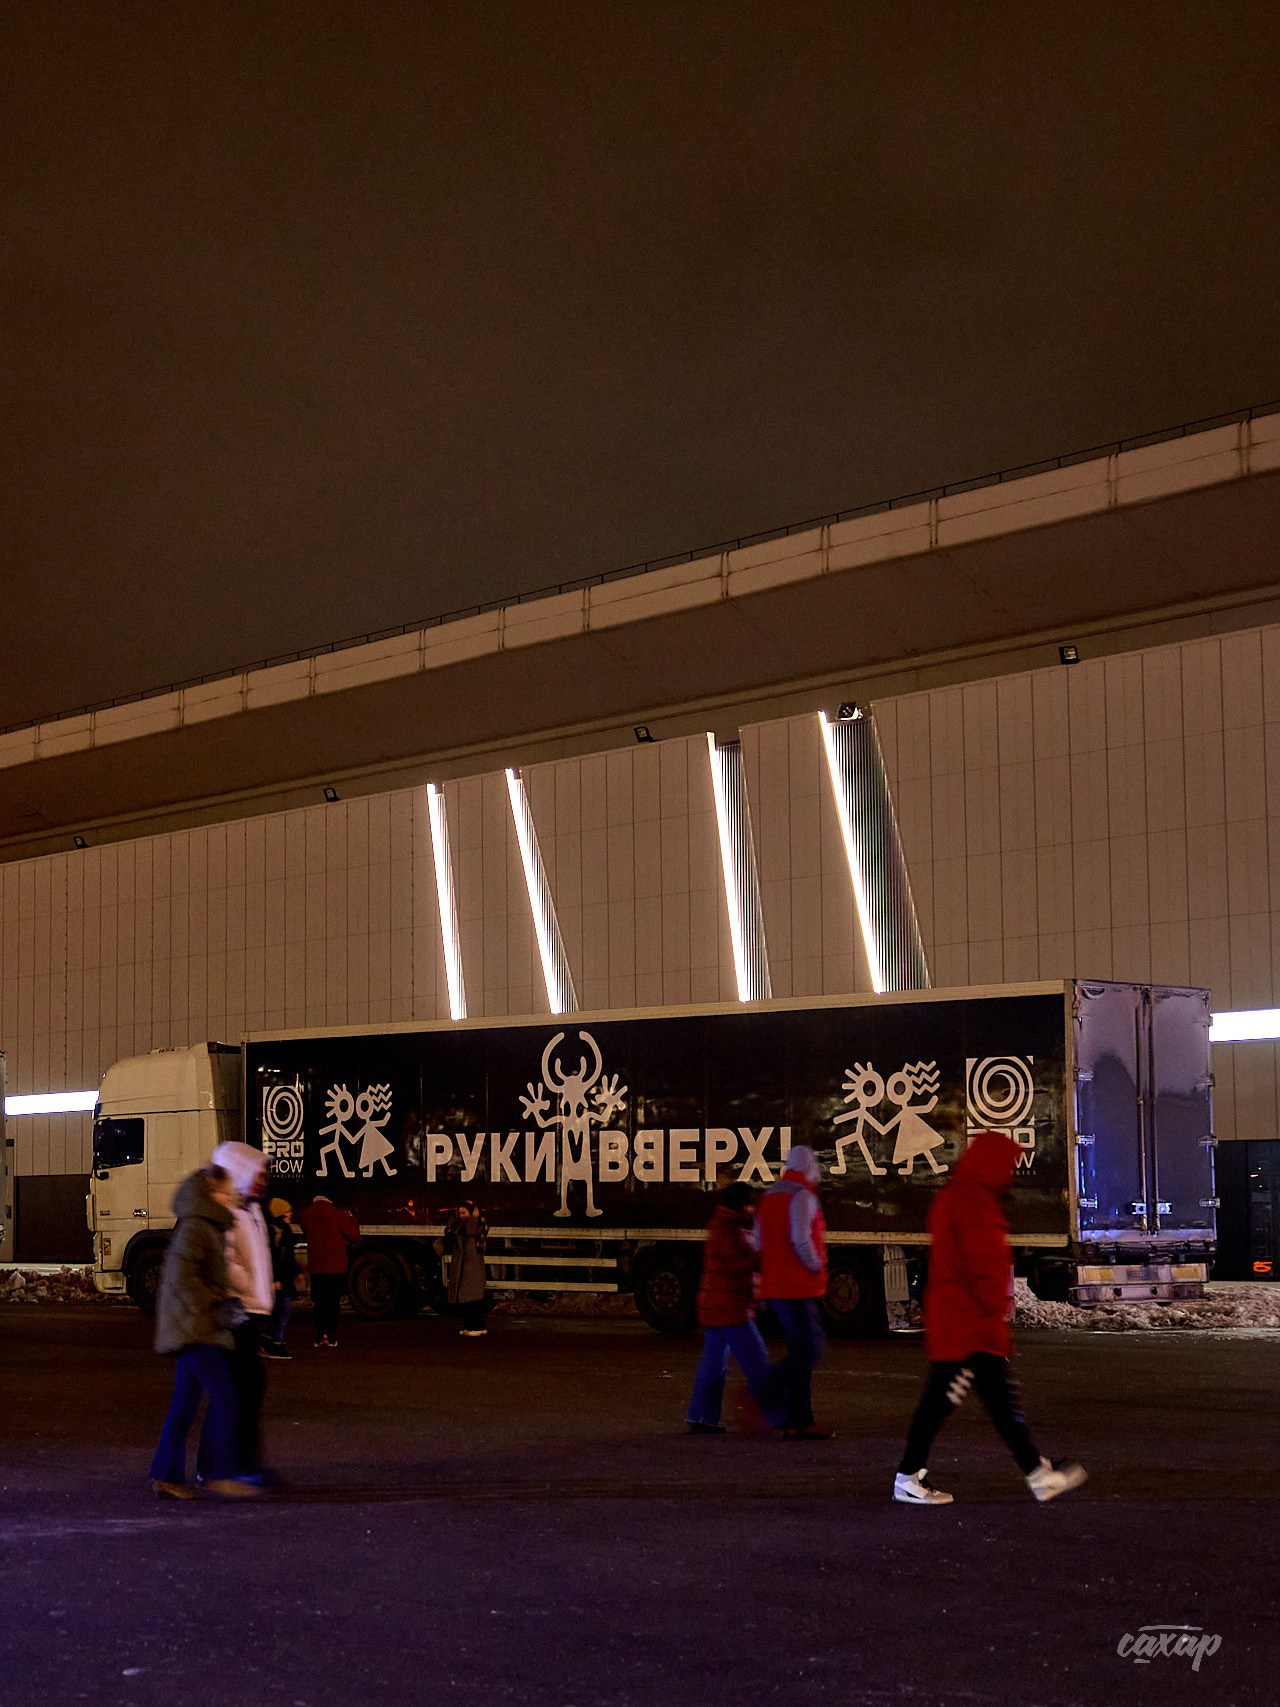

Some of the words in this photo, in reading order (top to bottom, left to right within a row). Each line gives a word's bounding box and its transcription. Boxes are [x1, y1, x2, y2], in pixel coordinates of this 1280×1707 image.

[263, 1141, 304, 1158] PRO
[426, 1131, 556, 1183] РУКИ
[270, 1159, 304, 1174] HOW
